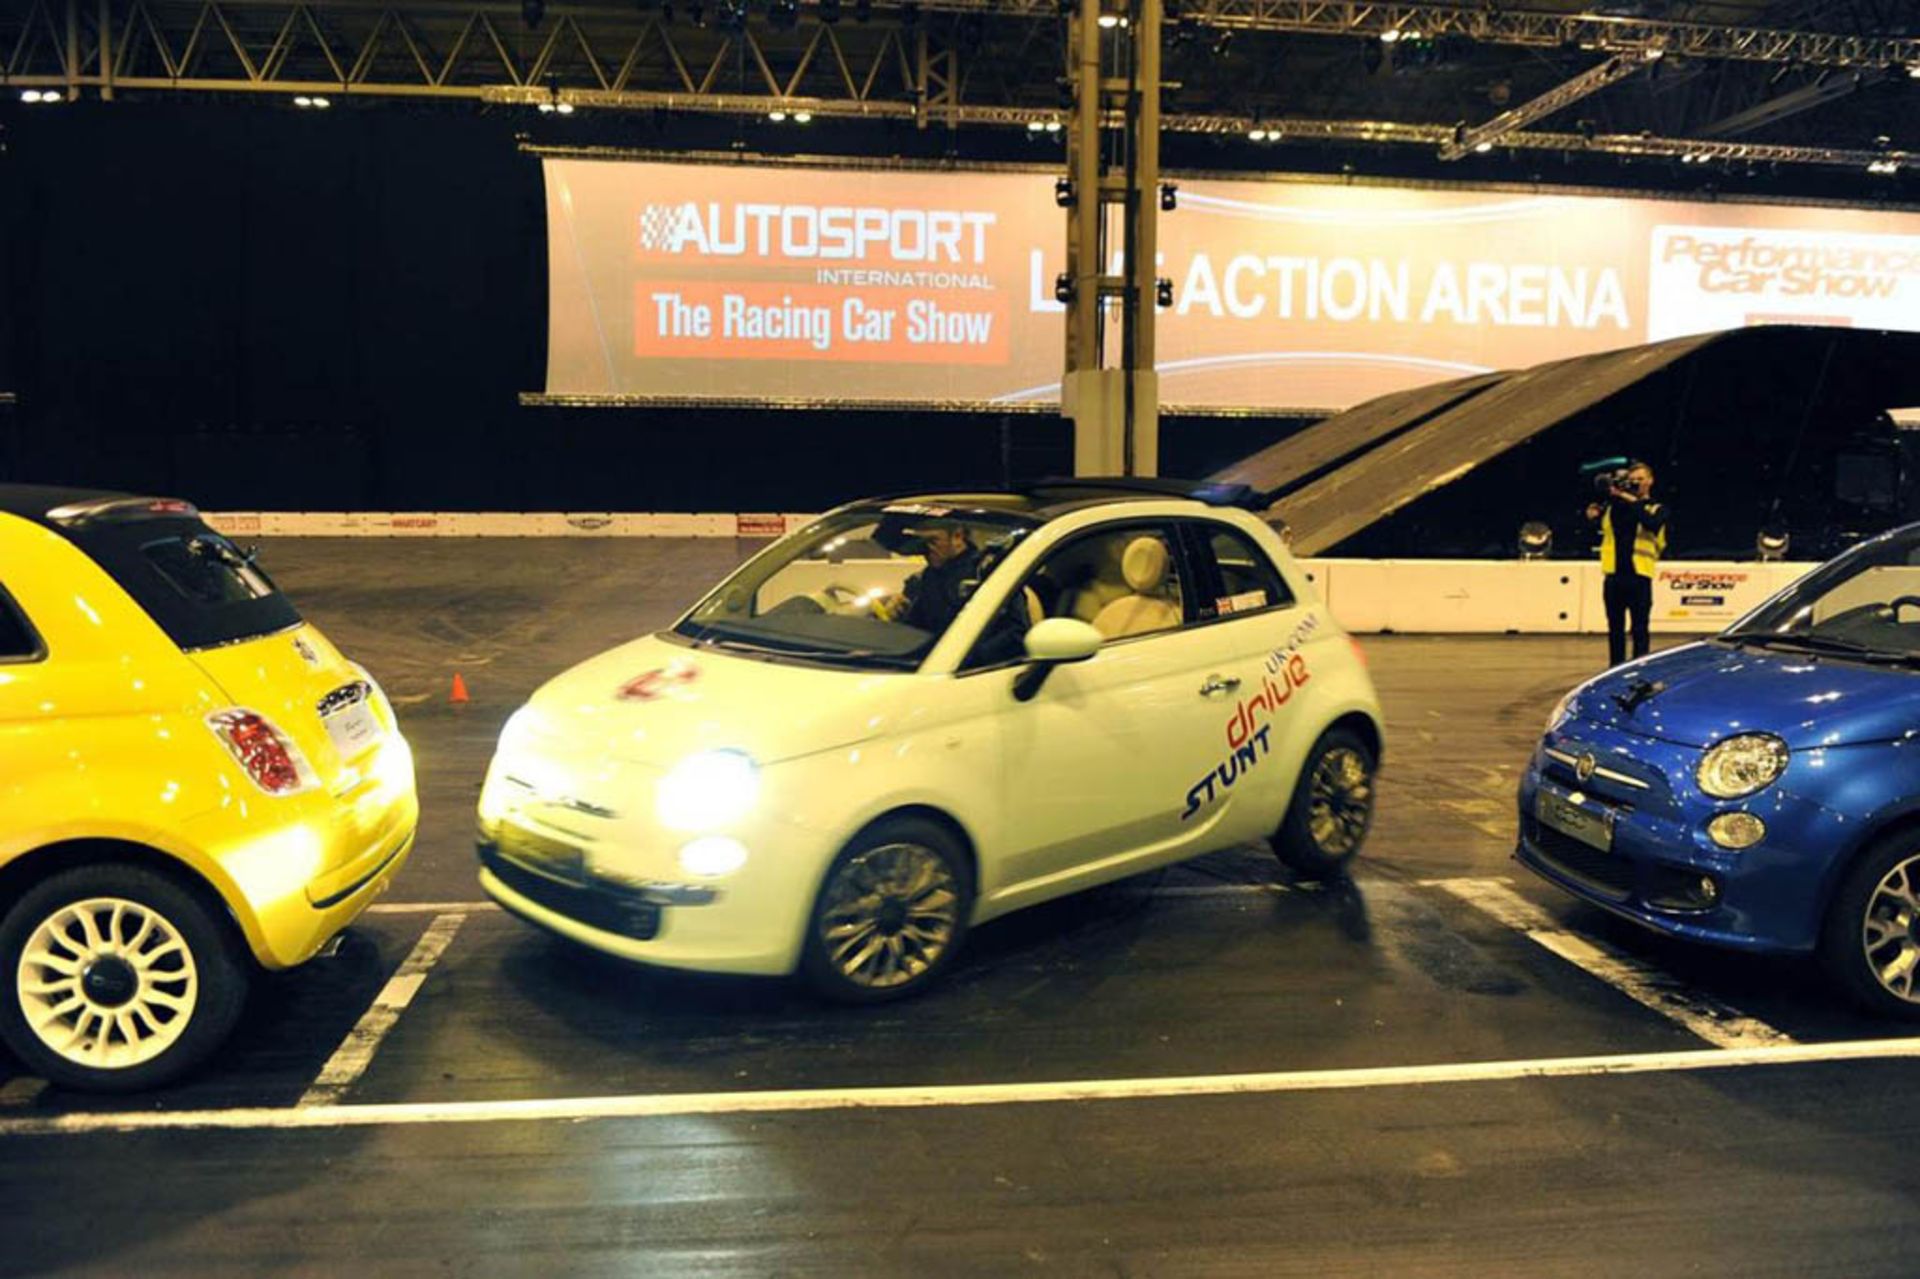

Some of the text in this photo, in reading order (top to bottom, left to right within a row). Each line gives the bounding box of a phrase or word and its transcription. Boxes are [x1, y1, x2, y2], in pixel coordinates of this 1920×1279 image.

[671, 204, 996, 263] AUTOSPORT
[816, 269, 994, 290] INTERNATIONAL
[1176, 253, 1402, 319] ACTION
[1419, 261, 1630, 329] ARENA
[1698, 263, 1898, 298] Car Show
[652, 293, 991, 350] The Racing Car Show
[1227, 654, 1311, 750] drive
[1181, 724, 1271, 821] STUNT
